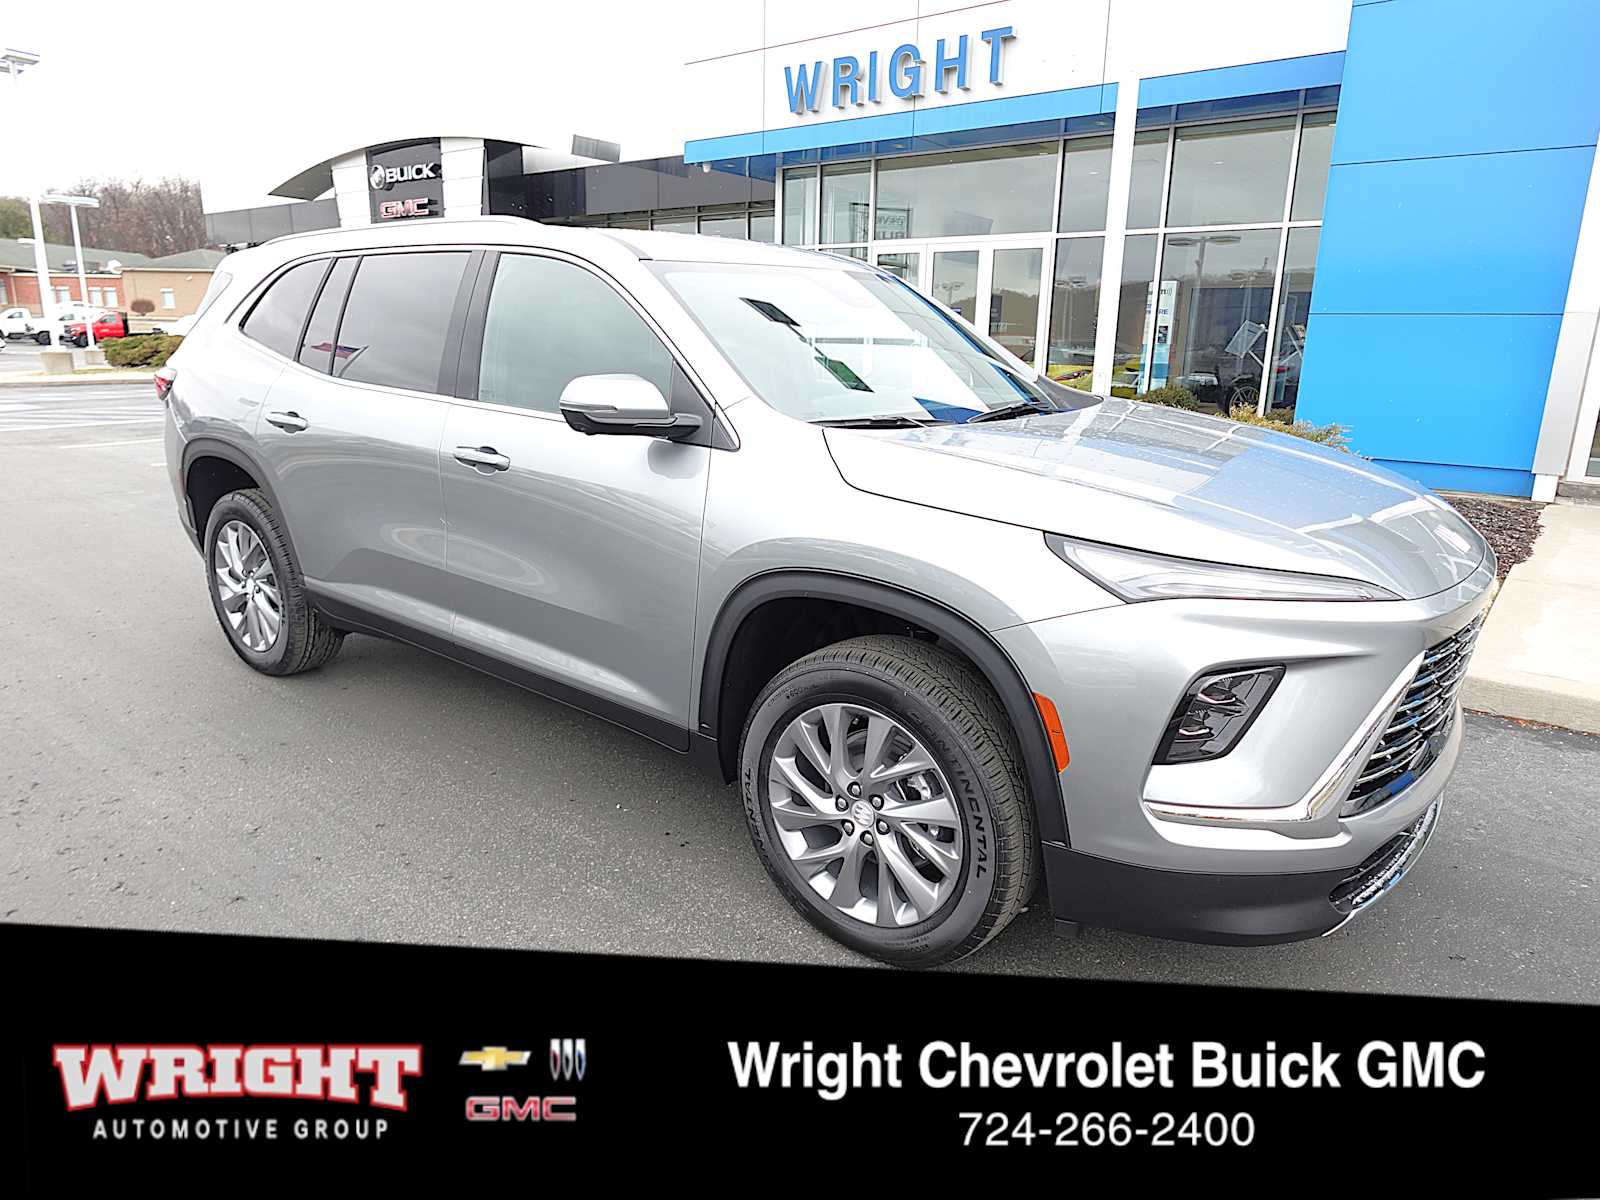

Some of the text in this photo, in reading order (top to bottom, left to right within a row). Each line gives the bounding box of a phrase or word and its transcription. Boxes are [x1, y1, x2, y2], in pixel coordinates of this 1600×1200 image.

[784, 26, 1015, 114] WRIGHT
[385, 163, 437, 183] BUICK
[380, 197, 430, 218] GMC
